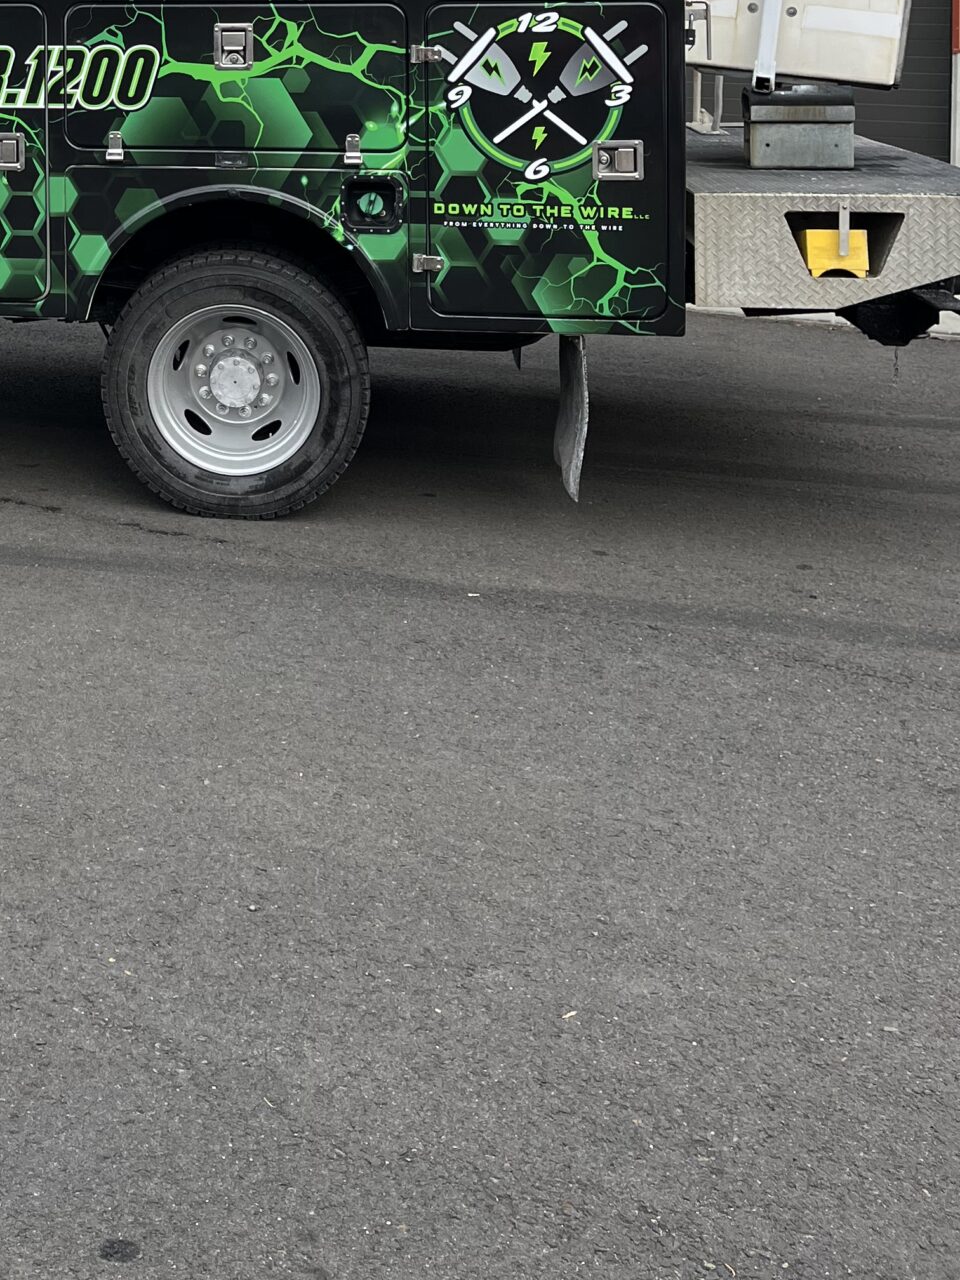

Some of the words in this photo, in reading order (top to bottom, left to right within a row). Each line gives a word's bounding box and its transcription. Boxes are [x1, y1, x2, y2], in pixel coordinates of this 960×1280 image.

[516, 12, 559, 33] 12
[447, 86, 473, 109] 9
[604, 85, 633, 107] 3
[524, 158, 550, 180] 6
[433, 202, 493, 217] DOWN
[499, 204, 525, 217] TO
[532, 205, 572, 218] THE
[581, 206, 634, 220] WIRE
